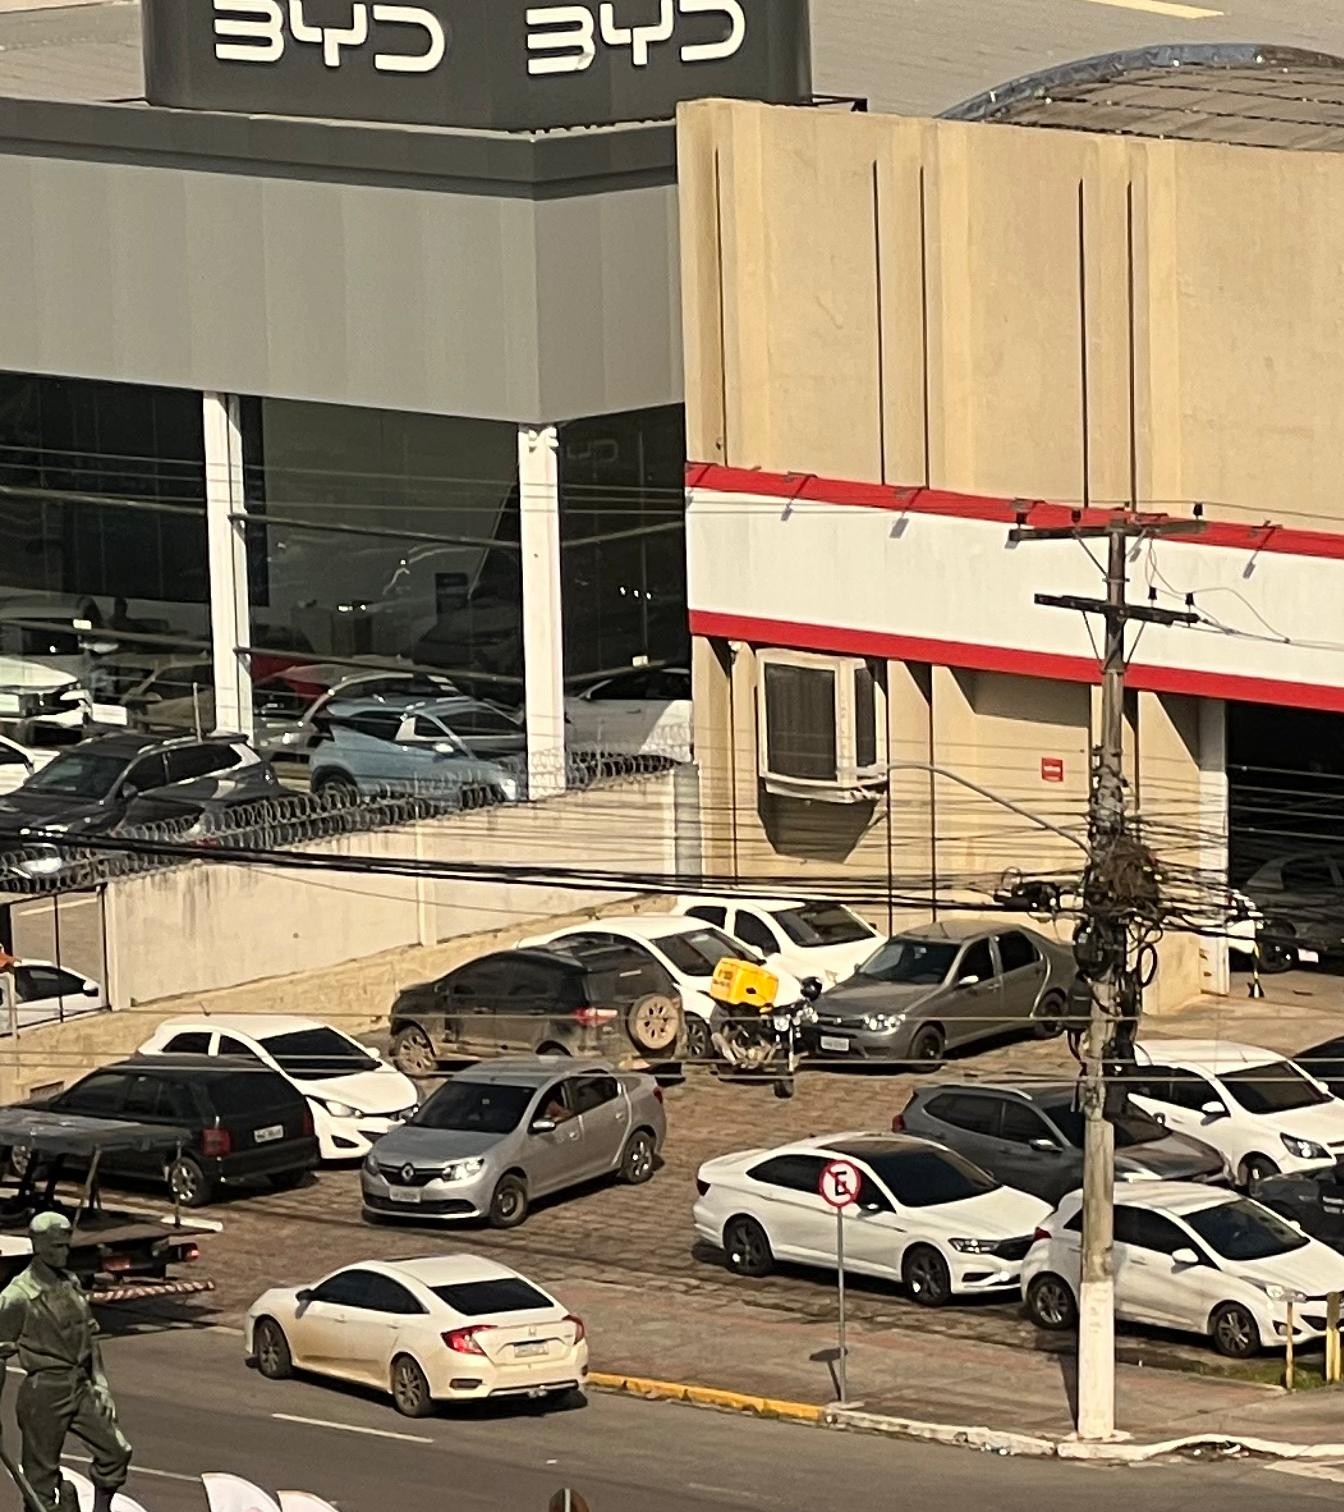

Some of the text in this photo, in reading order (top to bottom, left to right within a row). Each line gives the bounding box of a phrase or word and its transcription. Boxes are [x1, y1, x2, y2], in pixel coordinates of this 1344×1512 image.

[214, 0, 446, 73] BYD
[526, 0, 746, 75] BYD
[835, 1171, 850, 1196] E
